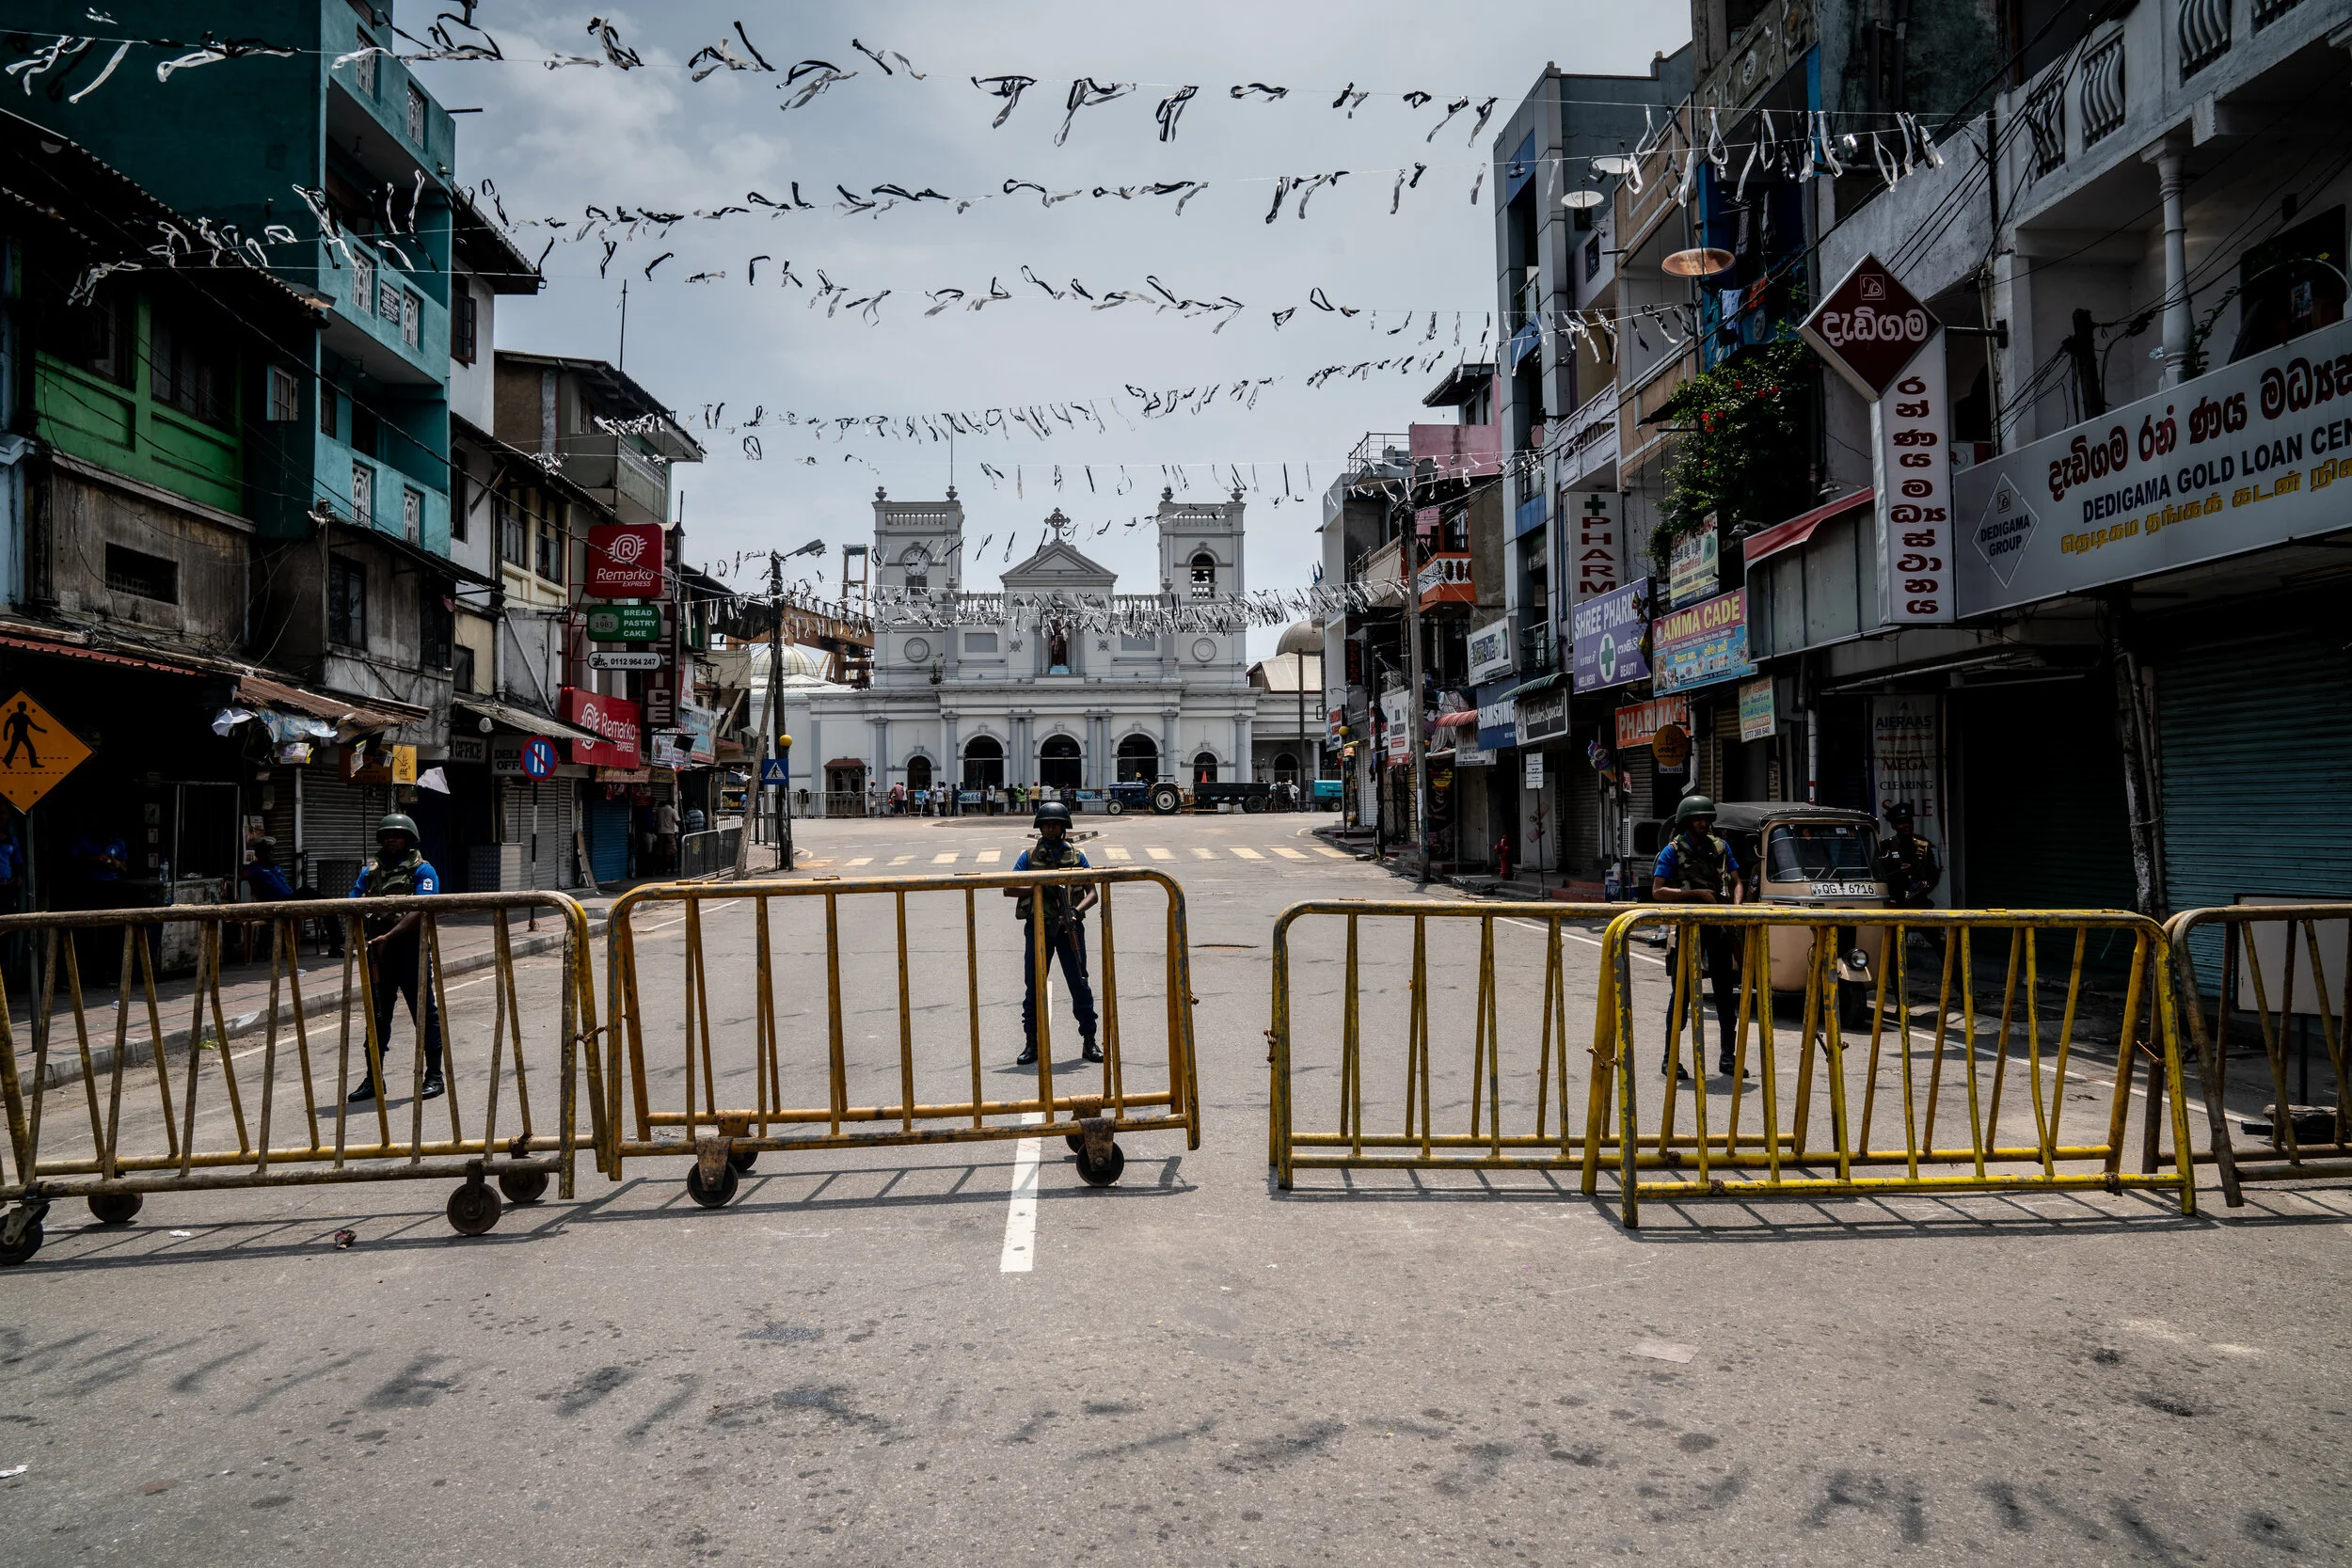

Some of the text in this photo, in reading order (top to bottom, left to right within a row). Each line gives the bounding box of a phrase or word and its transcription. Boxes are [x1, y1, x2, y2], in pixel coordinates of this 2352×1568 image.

[1822, 306, 1928, 347] දැඩිගම
[2048, 425, 2129, 502] දැඩිගම
[2082, 474, 2171, 524] DEDIGAMA
[2177, 455, 2234, 494] GOLD
[2242, 433, 2302, 476] LOAN
[1980, 515, 2030, 543] DEDIGAMA
[1989, 535, 2022, 557] GROUP
[596, 568, 654, 581] Remarko
[1575, 604, 1602, 641] SHREE
[1603, 589, 1642, 630] PHARM
[1663, 610, 1701, 641] AMMA
[1703, 595, 1740, 629] CADE
[1620, 661, 1637, 677] BEAUTY
[1478, 699, 1516, 730] SAMSUNG
[601, 712, 636, 740] Remarko
[455, 740, 482, 759] OFFICE
[616, 741, 634, 752] EXPRESS
[1883, 756, 1930, 771] MEGA
[1880, 781, 1933, 790] CLEARING
[1882, 799, 1933, 817] SLE
[1822, 884, 1837, 895] QG
[1849, 884, 1874, 895] 6716
